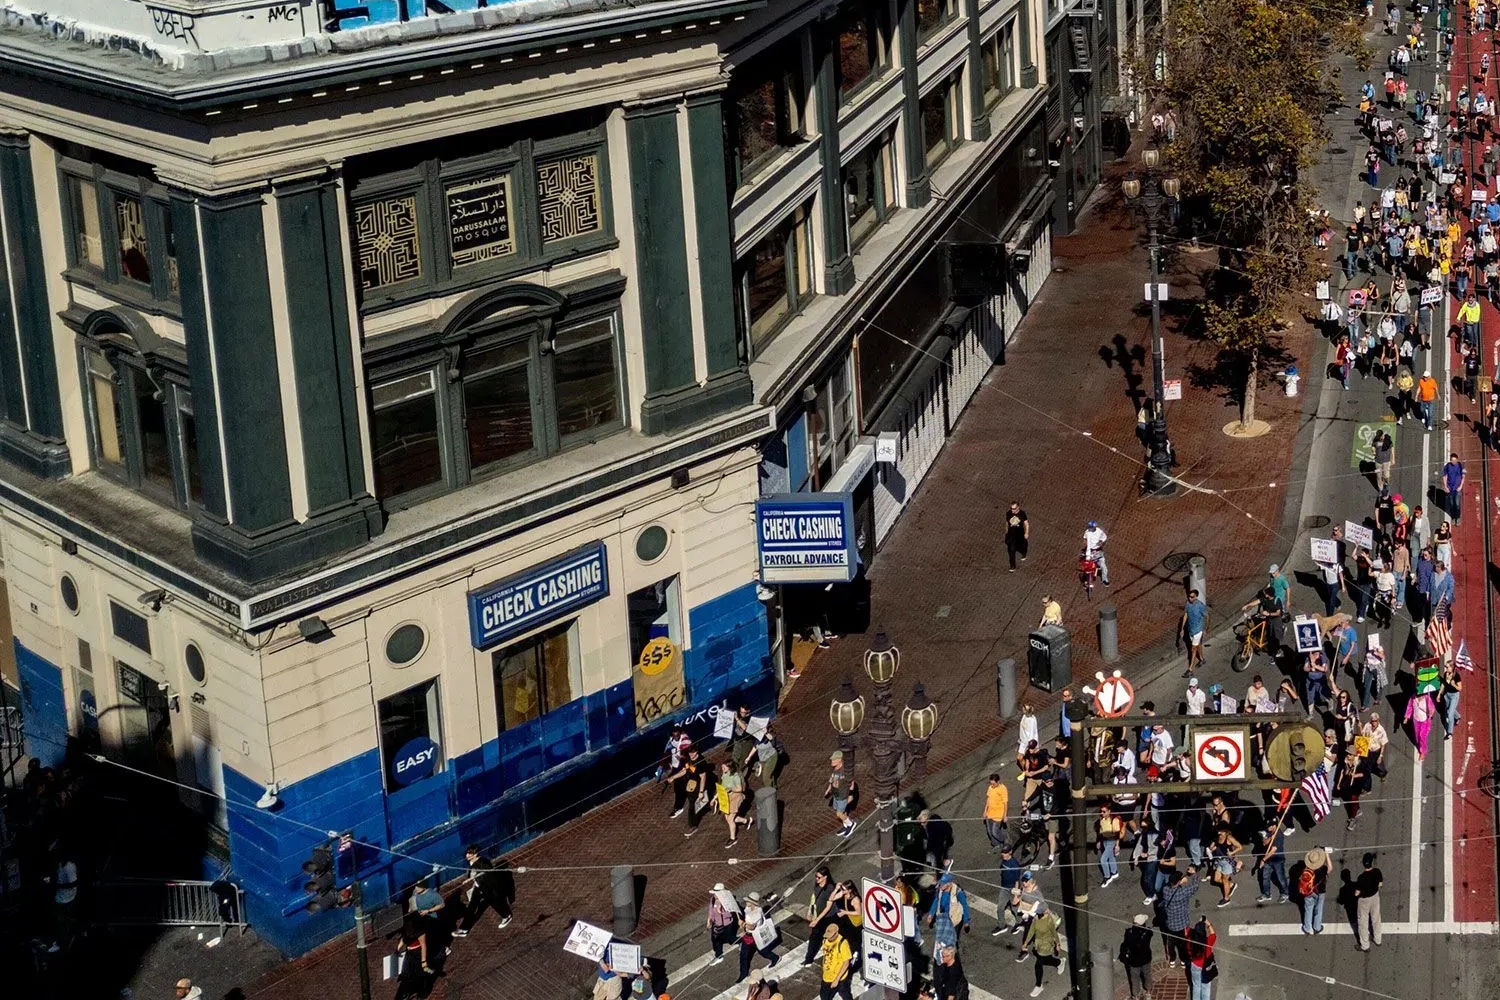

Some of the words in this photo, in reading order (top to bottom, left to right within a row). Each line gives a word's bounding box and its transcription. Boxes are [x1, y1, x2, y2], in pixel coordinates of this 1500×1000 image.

[453, 216, 507, 235] DARUSSALAM
[453, 224, 507, 243] mosque
[762, 517, 797, 540] CHECK
[798, 516, 843, 540] CASHING
[764, 554, 801, 565] PAYROLL
[804, 553, 844, 564] ADVANCE
[481, 587, 514, 604] CALIFORNIA
[482, 588, 535, 630] CHECK
[537, 560, 602, 607] CASHING
[396, 746, 434, 774] EASY
[870, 937, 897, 954] EXCEPT
